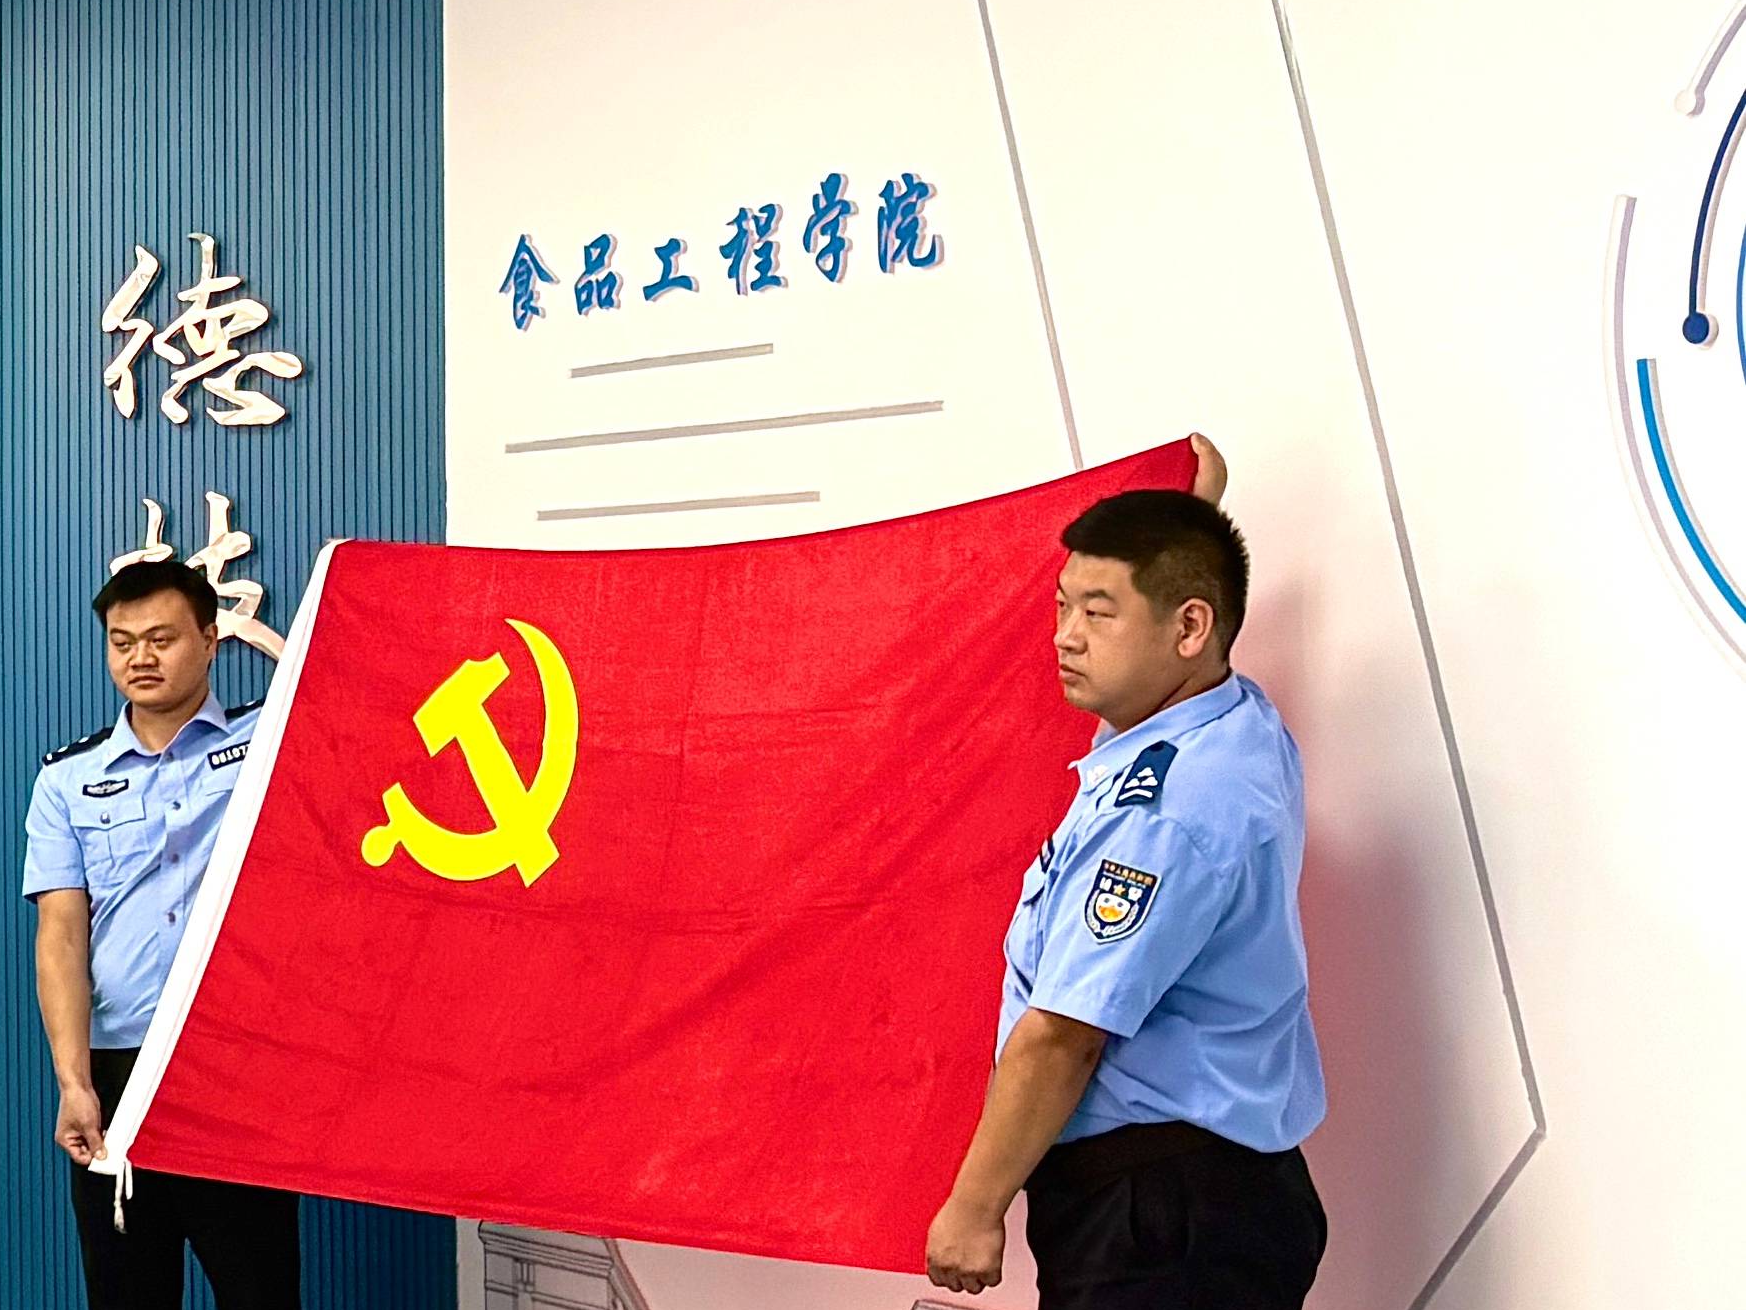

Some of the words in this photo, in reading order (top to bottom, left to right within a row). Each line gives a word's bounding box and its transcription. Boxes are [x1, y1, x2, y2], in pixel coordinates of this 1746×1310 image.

[499, 172, 942, 331] 食品工程学院
